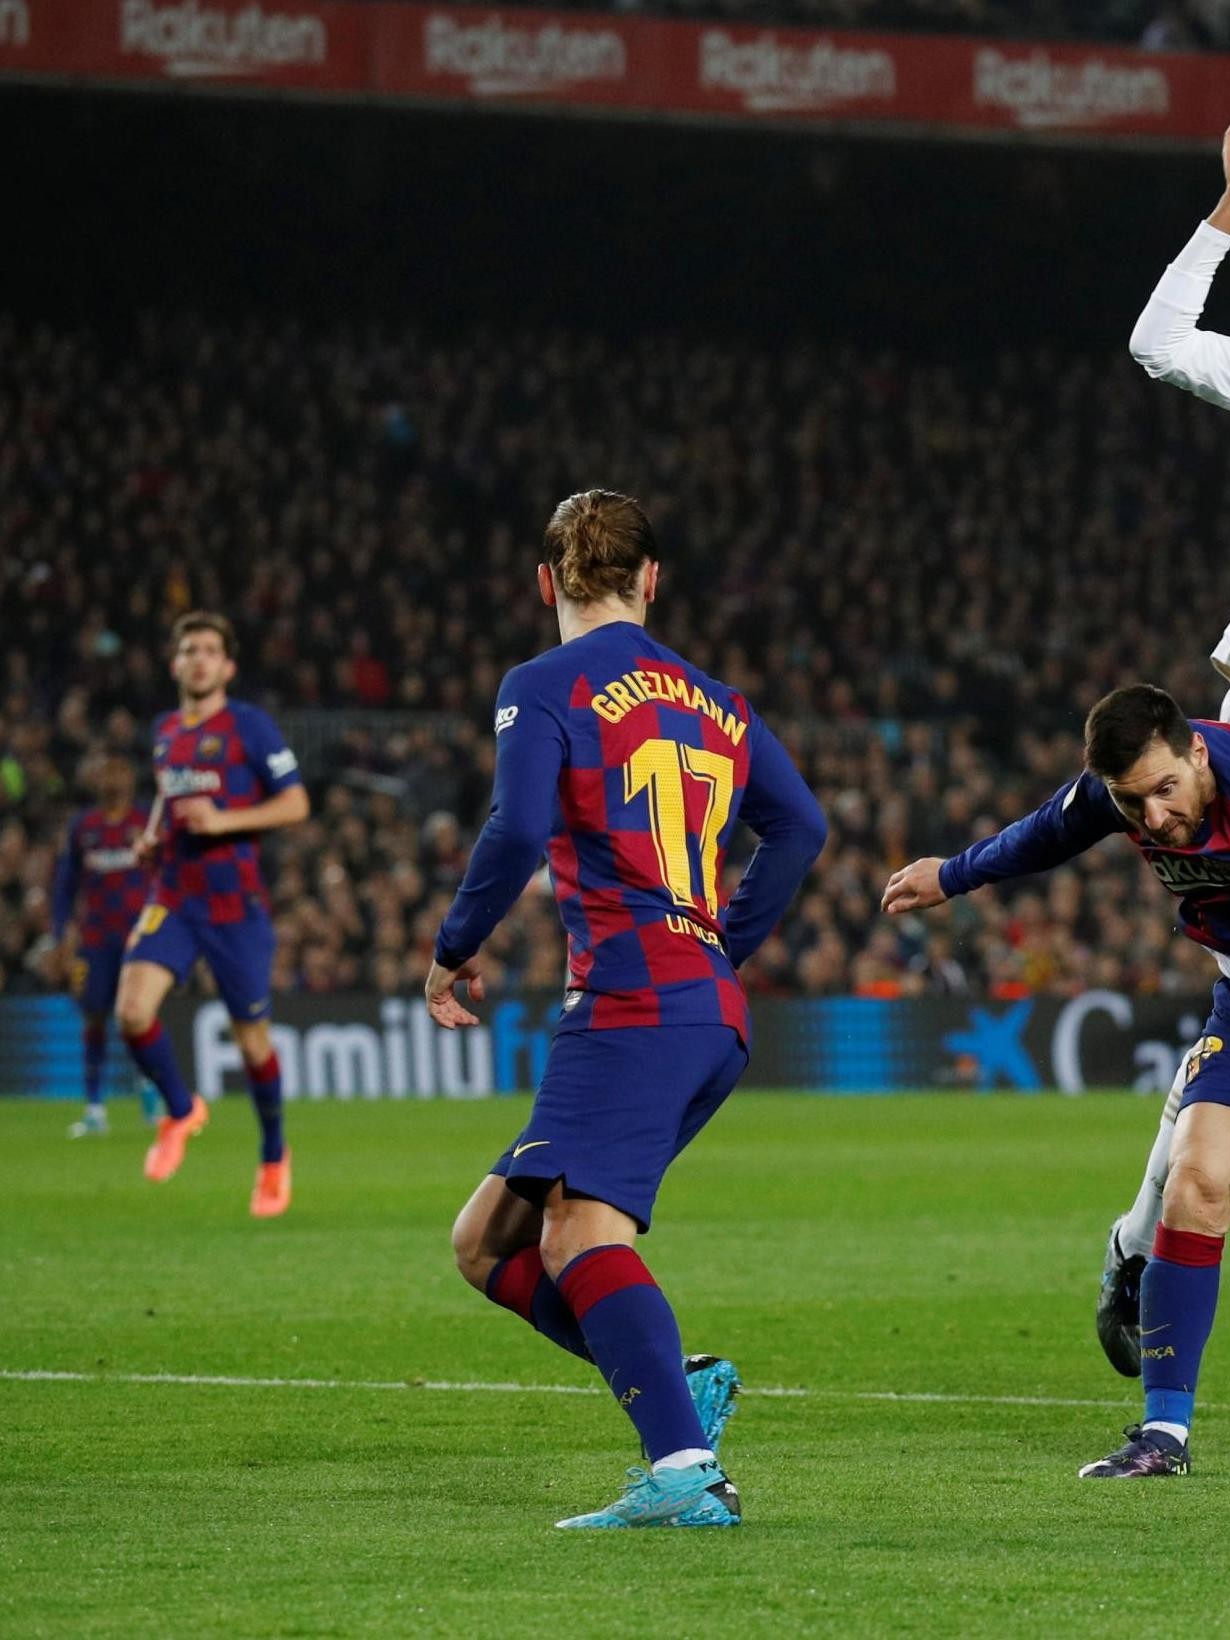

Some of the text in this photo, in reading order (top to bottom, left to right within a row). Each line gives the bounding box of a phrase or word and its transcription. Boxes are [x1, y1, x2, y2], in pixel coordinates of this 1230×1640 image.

[120, 0, 328, 66] Rakuten
[424, 14, 627, 82] Rakuten
[699, 31, 898, 99] Rakuten
[973, 49, 1170, 117] Rakuten
[591, 669, 748, 748] GRIEZMANN
[623, 738, 736, 921] 17
